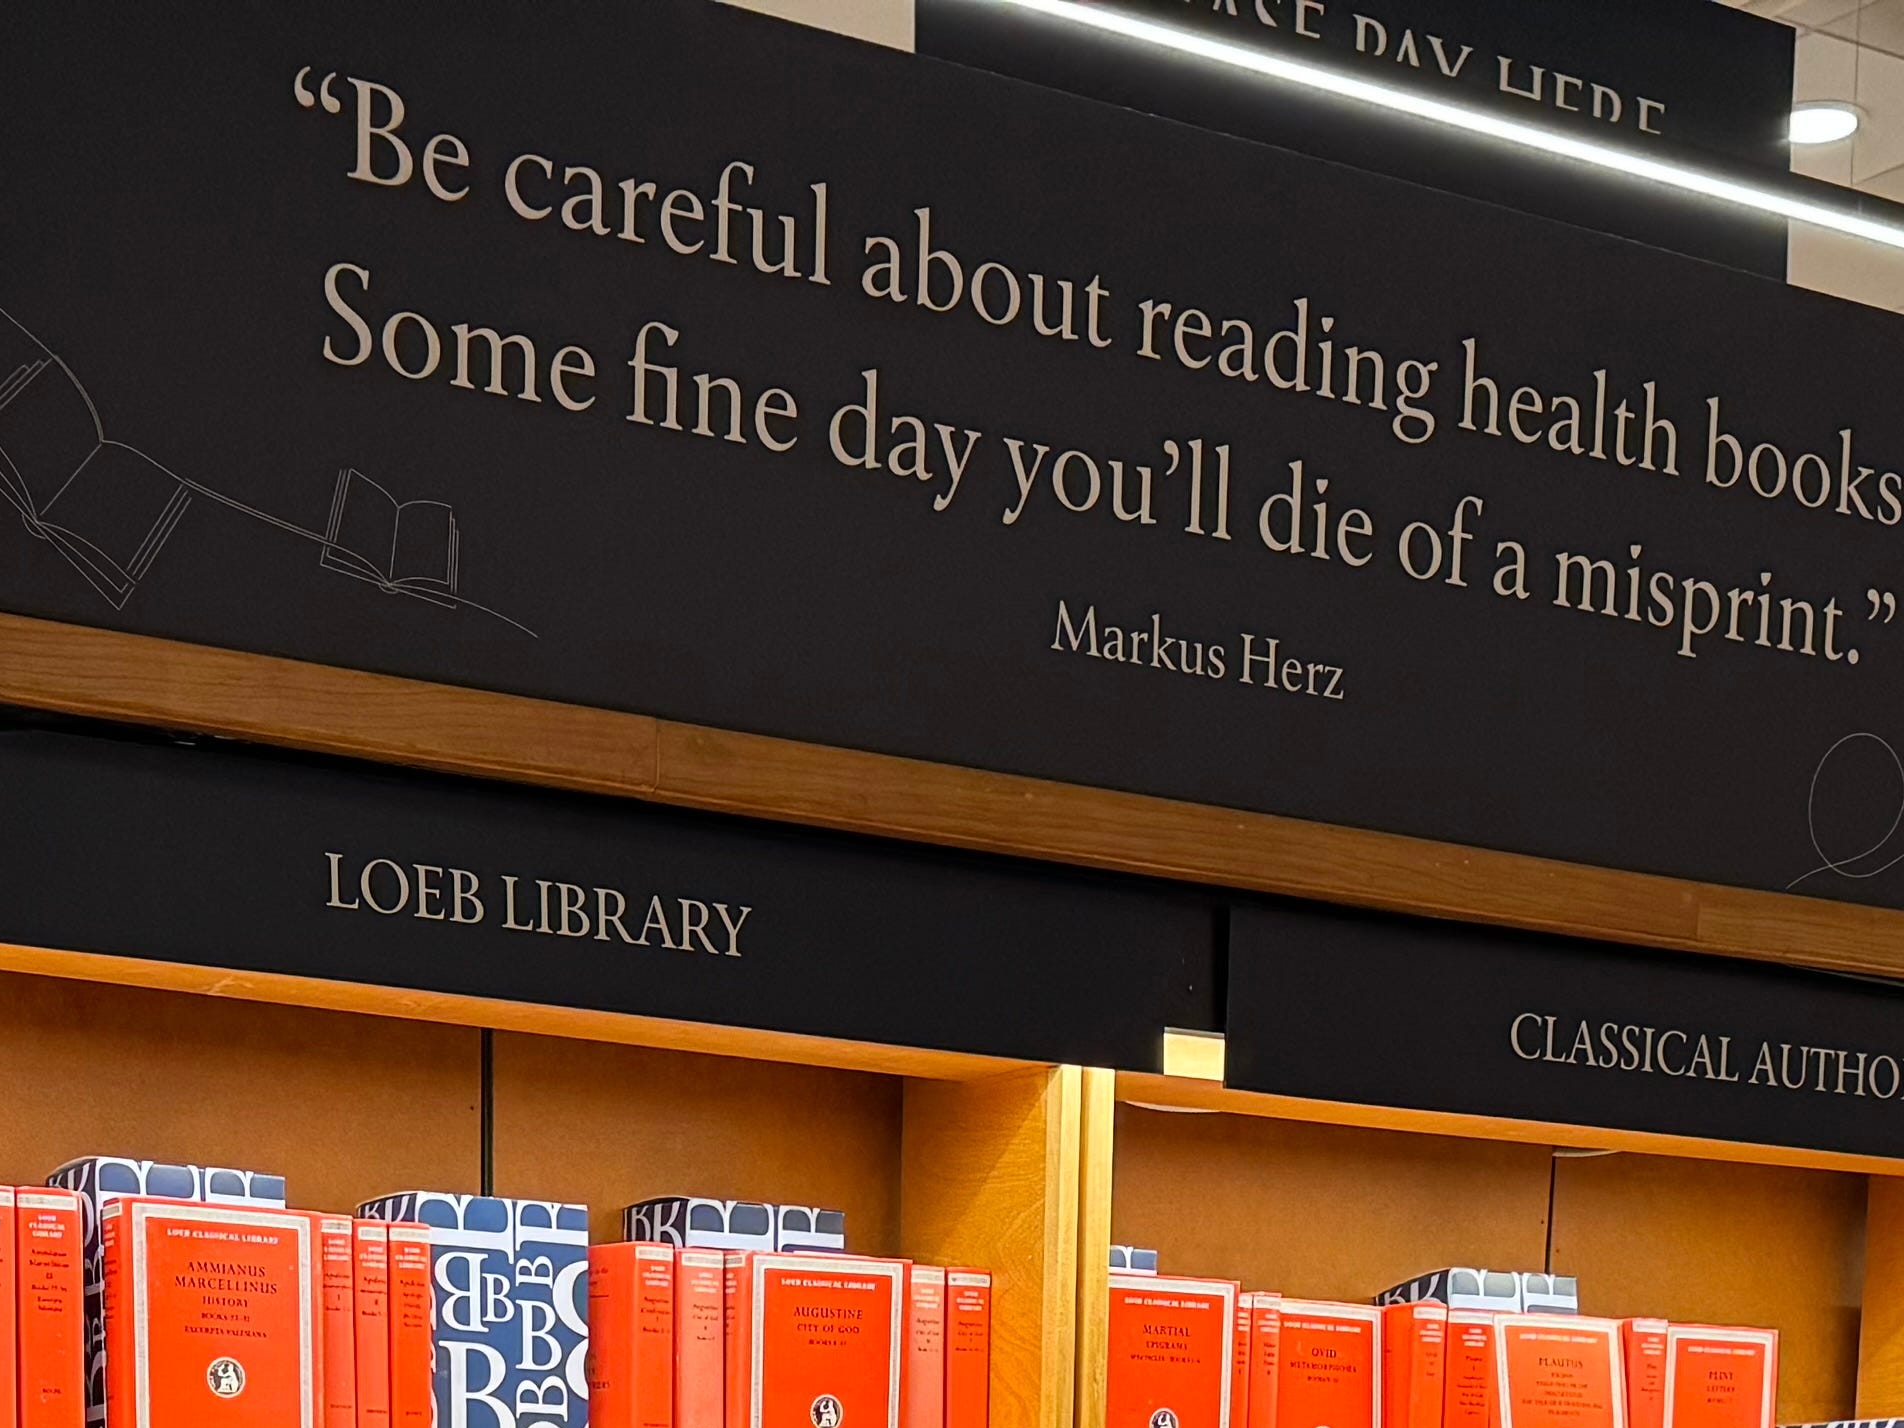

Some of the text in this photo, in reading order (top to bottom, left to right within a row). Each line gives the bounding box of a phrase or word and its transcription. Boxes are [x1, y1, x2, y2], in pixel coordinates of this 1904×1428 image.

[505, 155, 830, 285] careful
[862, 207, 1111, 347] about
[1137, 298, 1438, 443] reading
[1458, 338, 1679, 475] health
[323, 263, 595, 410] Some
[626, 322, 797, 451] fine
[830, 369, 981, 511] day
[1260, 460, 1372, 566] die
[1399, 496, 1483, 586] of
[1494, 542, 1530, 599] a
[1051, 601, 1343, 699] Markus Herz
[325, 852, 752, 956] LOEB LIBRARY
[1511, 1013, 1739, 1081] CLASSICAL
[188, 1261, 265, 1278] AMMIANUS
[174, 1275, 277, 1294] MARCELLINUS
[202, 1296, 248, 1308] HISTORY
[793, 1306, 863, 1321] AUGUSTINE
[1143, 1323, 1190, 1337] MARTIAL
[1311, 1347, 1337, 1358] OVID
